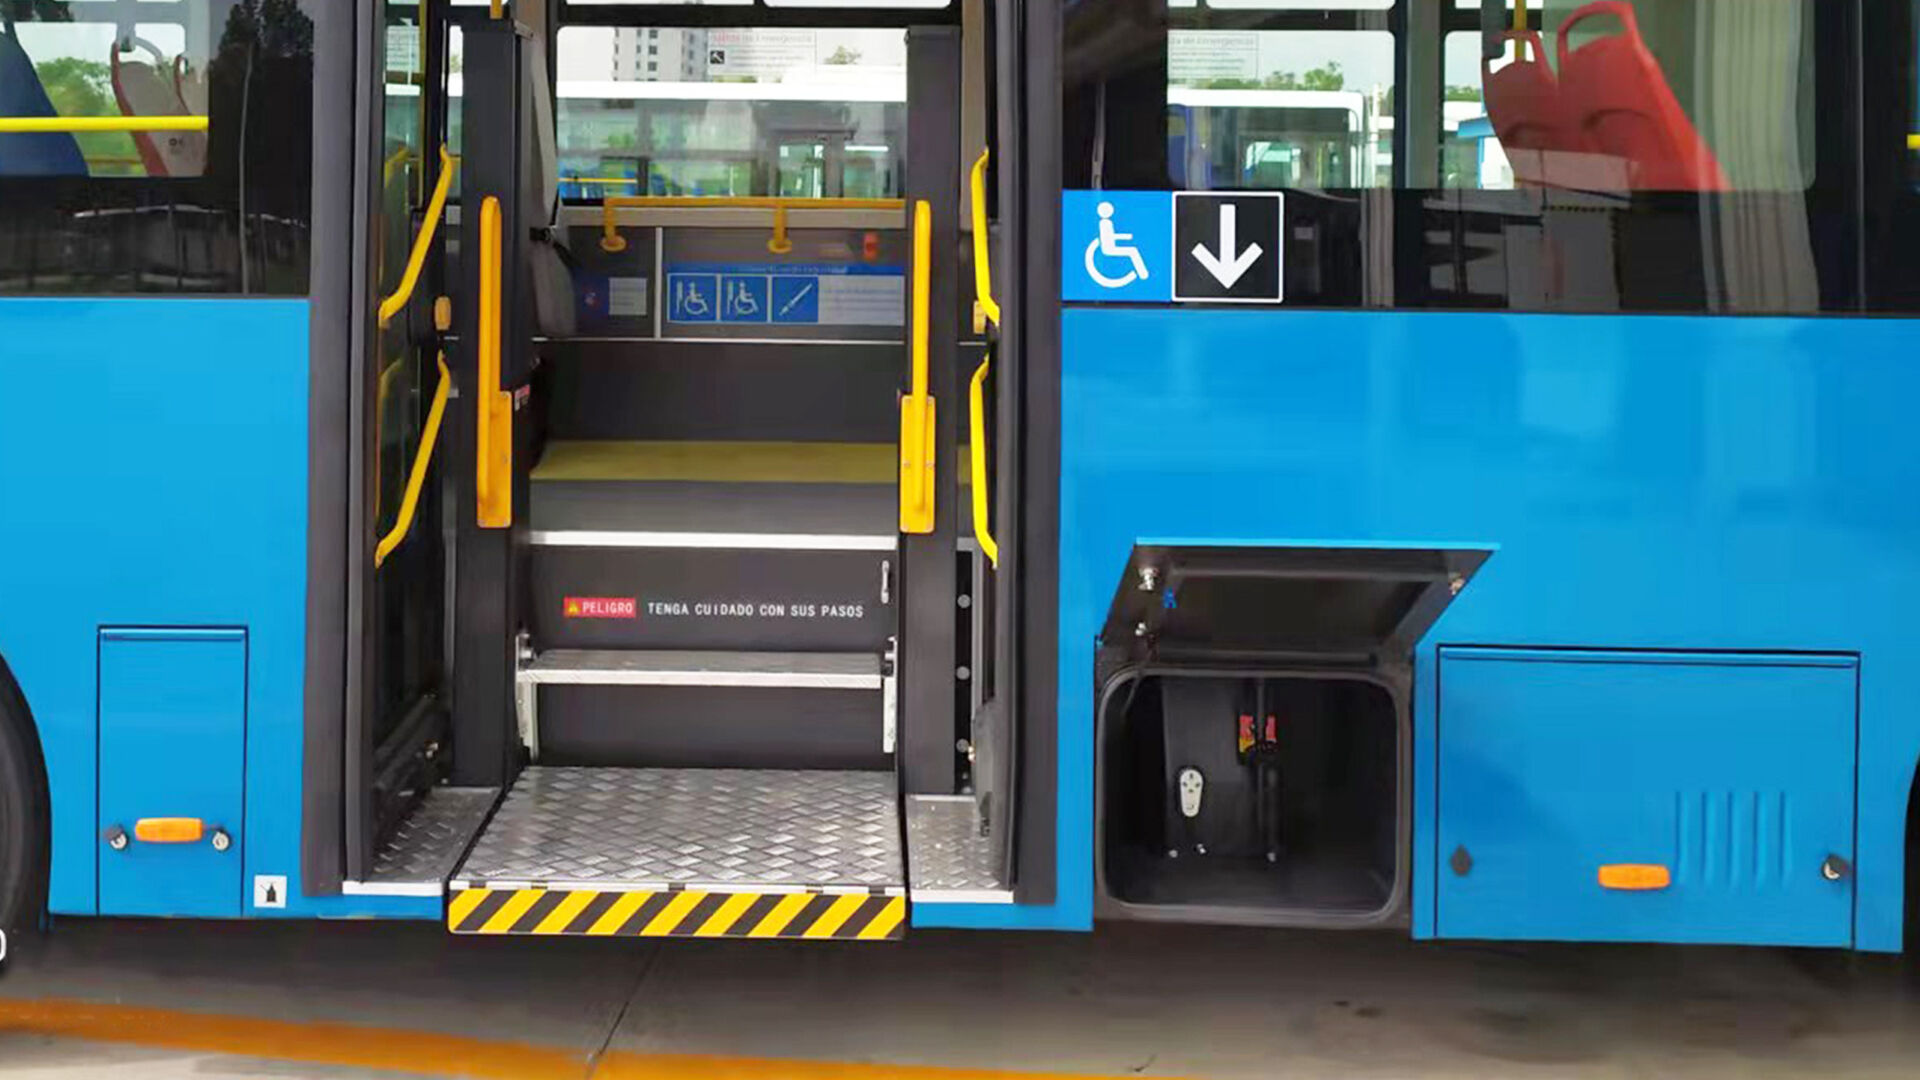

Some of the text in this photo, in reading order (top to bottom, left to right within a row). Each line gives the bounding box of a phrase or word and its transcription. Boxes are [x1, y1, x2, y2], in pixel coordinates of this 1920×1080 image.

[582, 601, 864, 618] PELIGRO TENGA CUIDADO CON SUS PASOS
